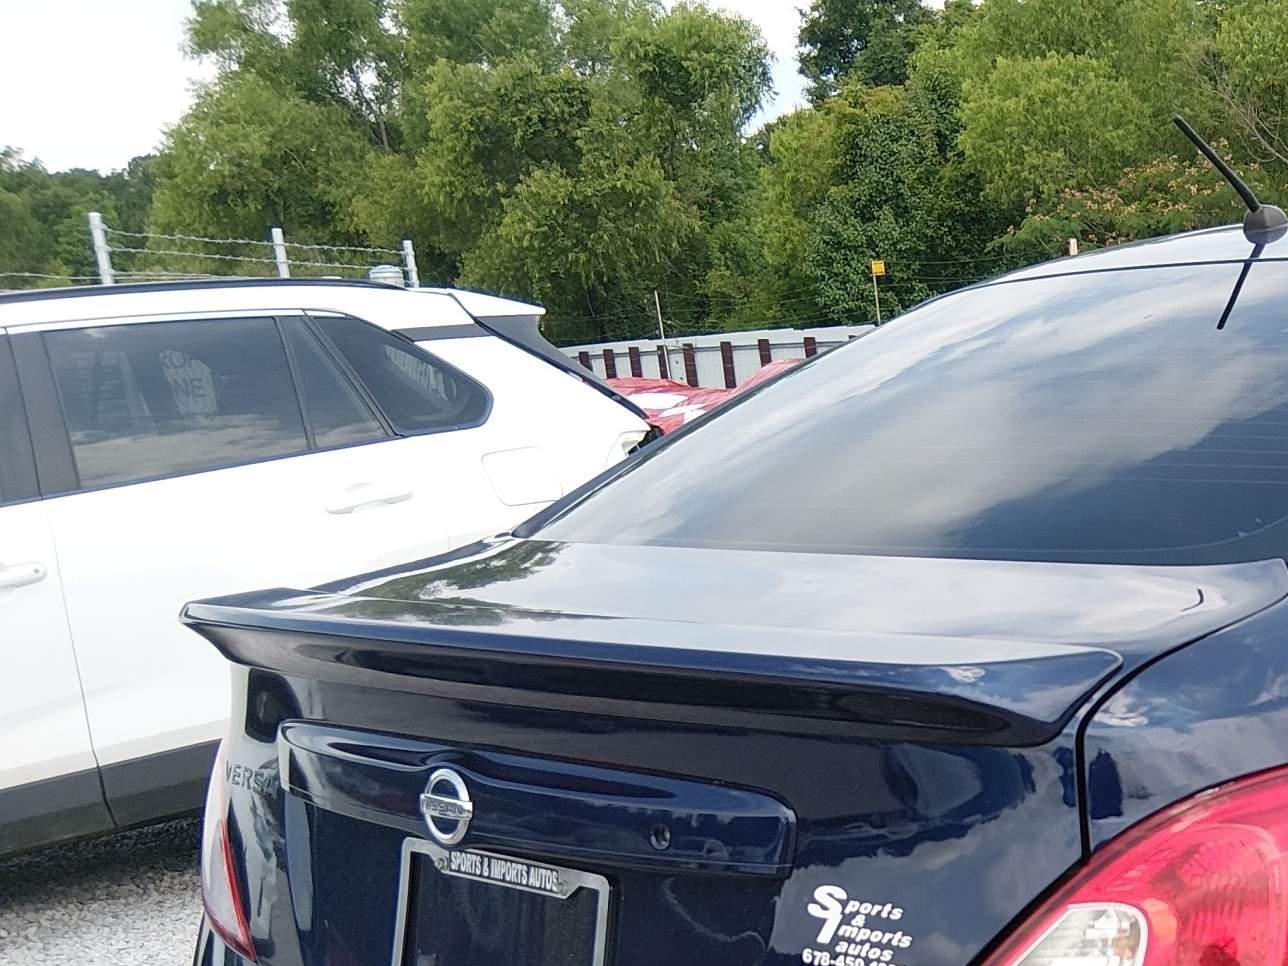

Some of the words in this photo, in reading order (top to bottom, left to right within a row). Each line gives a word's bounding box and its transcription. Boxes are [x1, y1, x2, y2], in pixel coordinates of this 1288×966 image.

[225, 759, 274, 793] VERSA
[450, 851, 482, 875] SPORTS
[482, 857, 490, 877] &
[490, 859, 528, 885] IMPORTS
[528, 866, 559, 892] AUTOS
[807, 884, 904, 920] Sports
[850, 914, 866, 928] &
[834, 941, 894, 962] autos
